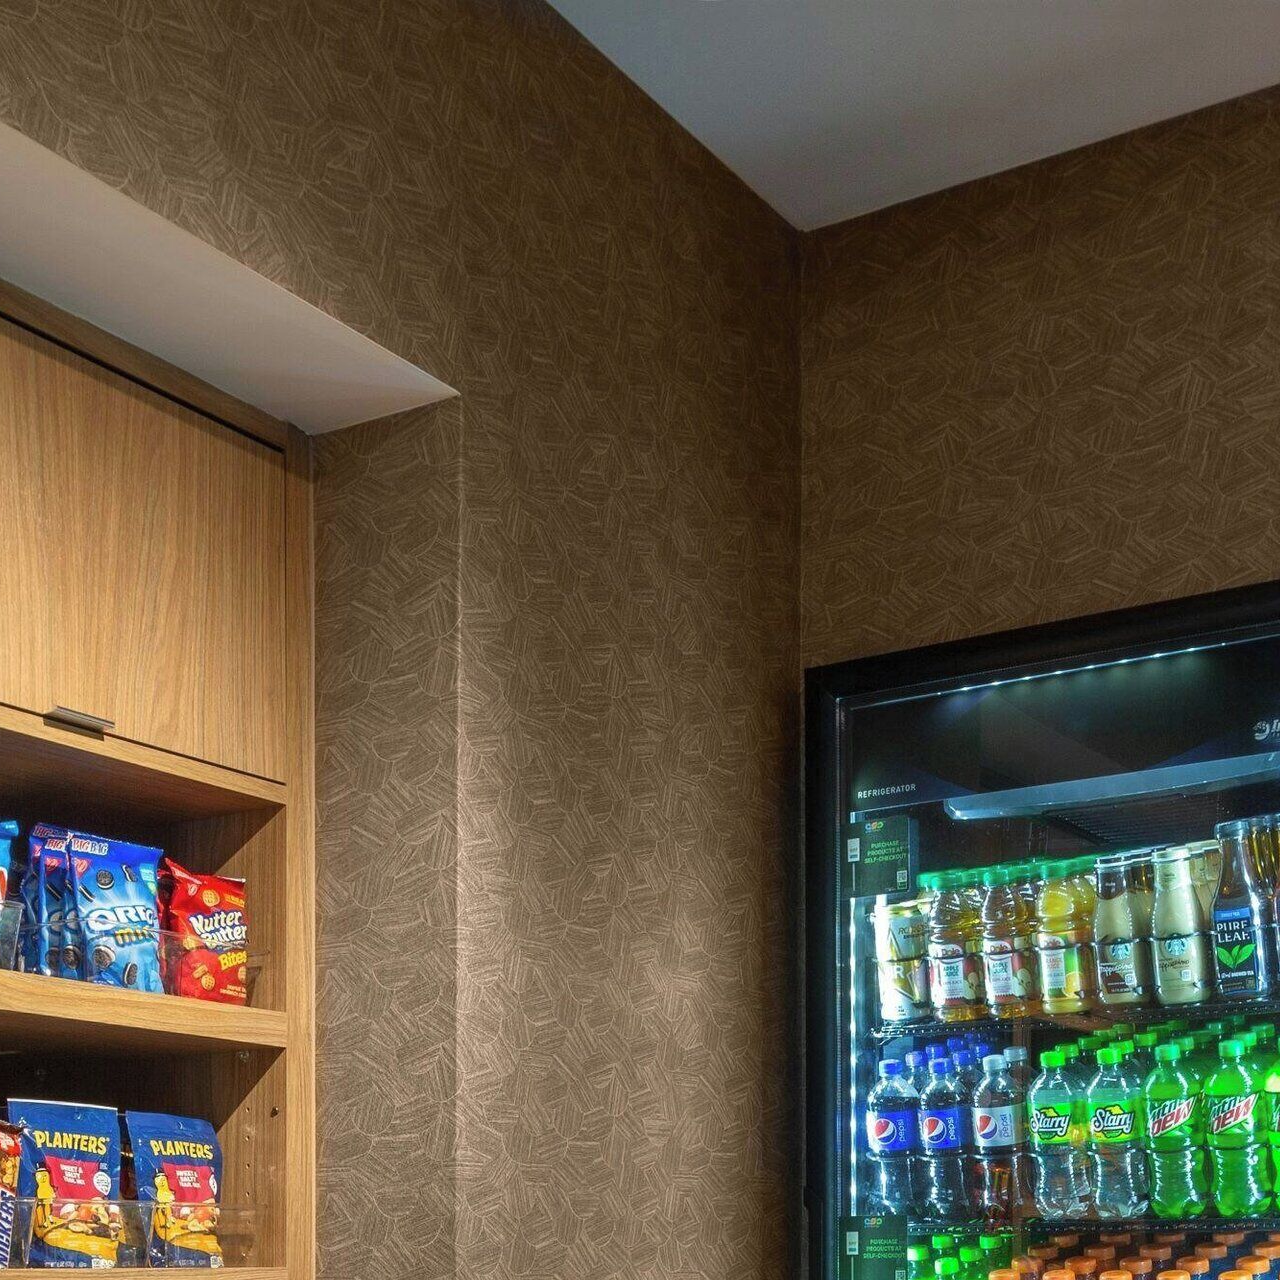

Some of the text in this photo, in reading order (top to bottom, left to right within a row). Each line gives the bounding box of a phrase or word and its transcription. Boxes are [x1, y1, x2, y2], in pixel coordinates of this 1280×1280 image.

[858, 784, 917, 799] REFRIGERATOR
[867, 848, 894, 856] PRODUCTS
[870, 840, 900, 849] PURCHASE
[864, 853, 907, 864] SELF-CHECKOUT
[189, 910, 243, 935] Nutter
[199, 925, 248, 948] Butter
[218, 951, 248, 971] Bites
[898, 1119, 907, 1142] pepsi
[947, 1117, 957, 1141] pepsi
[1030, 1109, 1071, 1136] Starry
[1093, 1107, 1134, 1134] Starry
[33, 1130, 107, 1155] PLANTERS
[150, 1140, 214, 1160] PLANTERS
